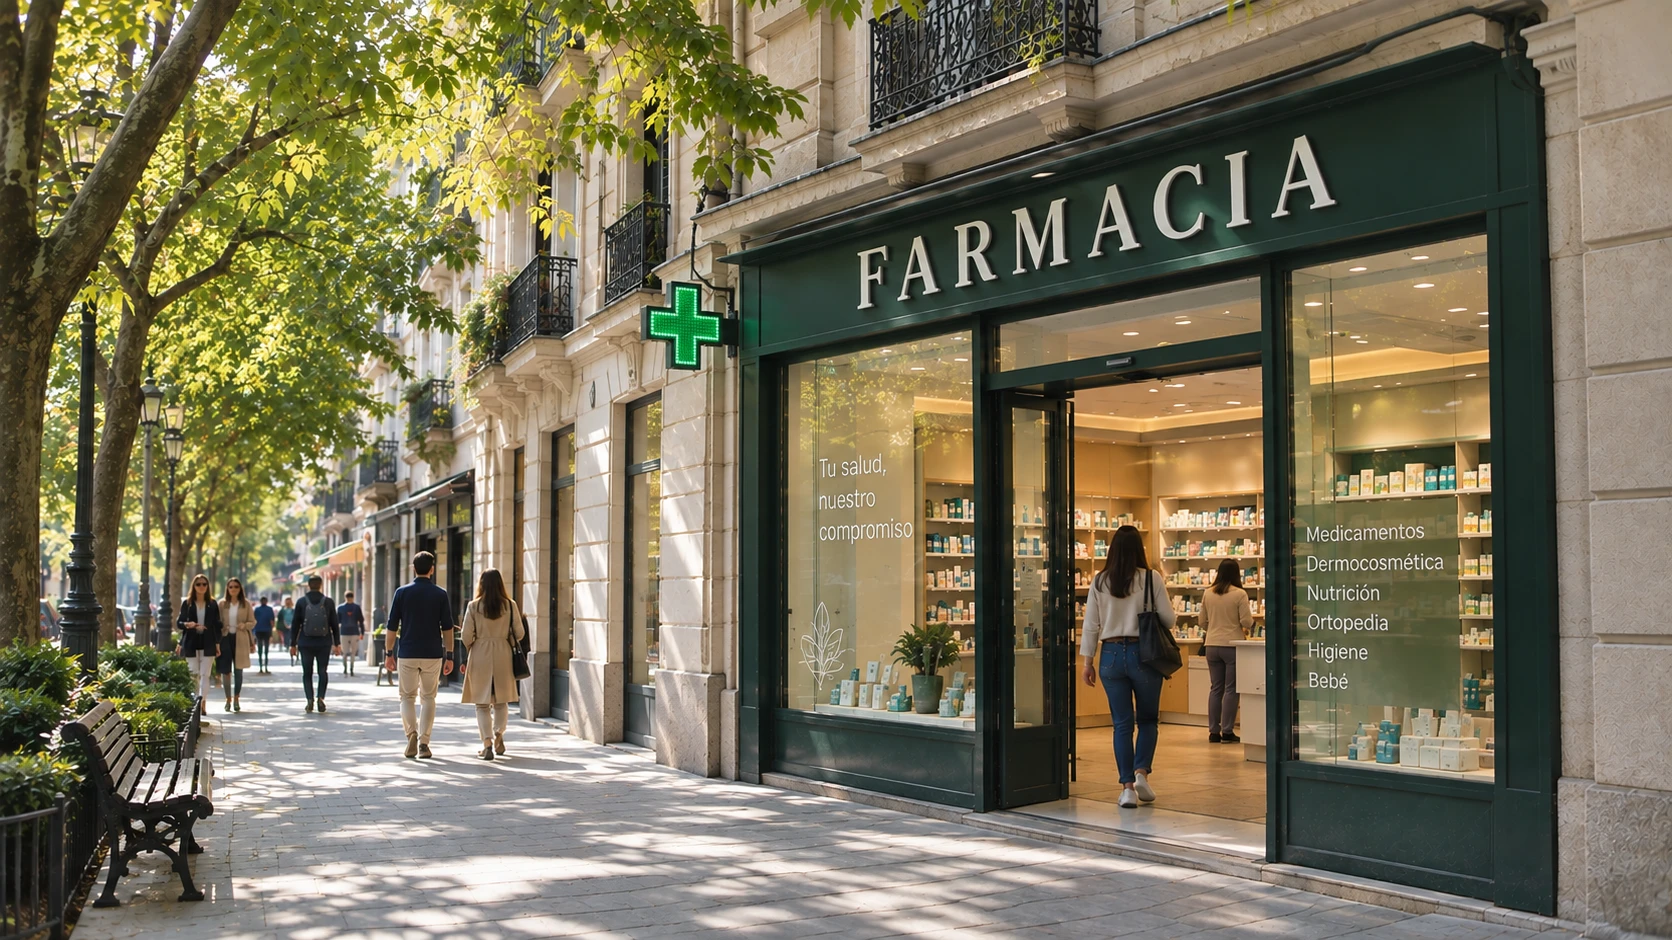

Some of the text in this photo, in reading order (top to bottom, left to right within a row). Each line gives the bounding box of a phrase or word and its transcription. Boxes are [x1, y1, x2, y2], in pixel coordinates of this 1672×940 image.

[857, 134, 1337, 310] FARMACIA
[819, 453, 887, 478] Tu salud,
[818, 488, 876, 510] nuestro
[819, 517, 913, 544] compromiso
[1306, 523, 1425, 543] Medicamentos
[1306, 553, 1444, 572] Dermocosmética
[1307, 583, 1380, 602] Nutrición
[1307, 613, 1389, 634] Ortopedia
[1308, 642, 1369, 664] Higiene
[1308, 671, 1349, 690] Bebé
